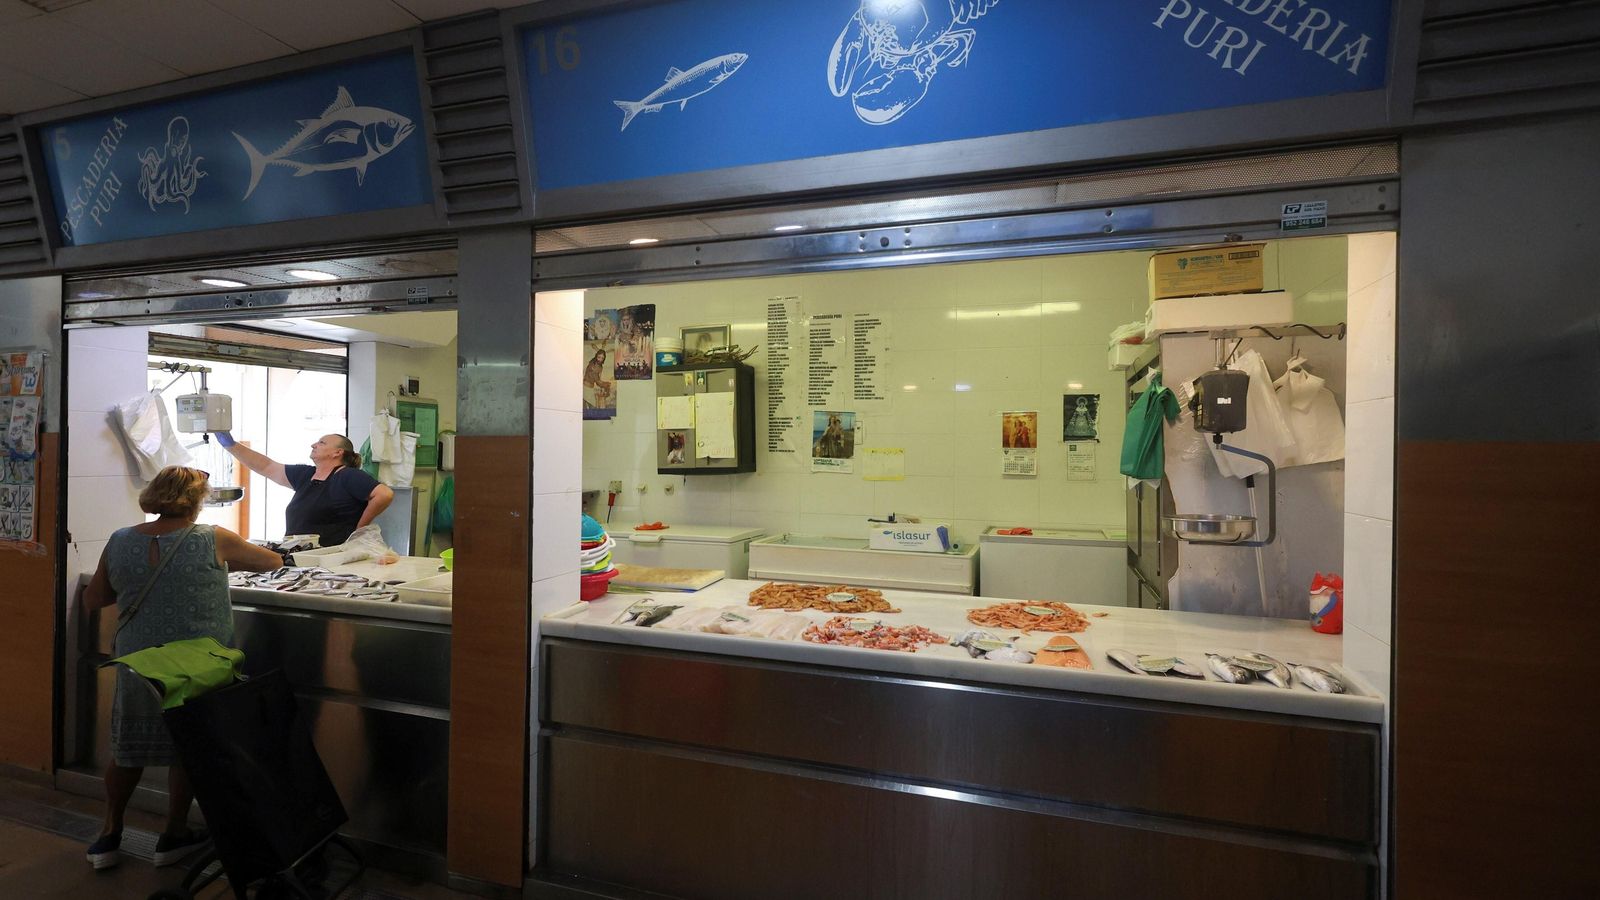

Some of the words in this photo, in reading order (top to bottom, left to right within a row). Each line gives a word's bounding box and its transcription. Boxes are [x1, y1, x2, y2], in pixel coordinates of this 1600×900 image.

[530, 25, 582, 75] 16
[1151, 0, 1268, 76] PURI
[61, 116, 128, 241] PESCADERIA
[89, 171, 124, 228] PURI
[893, 531, 931, 540] islasur
